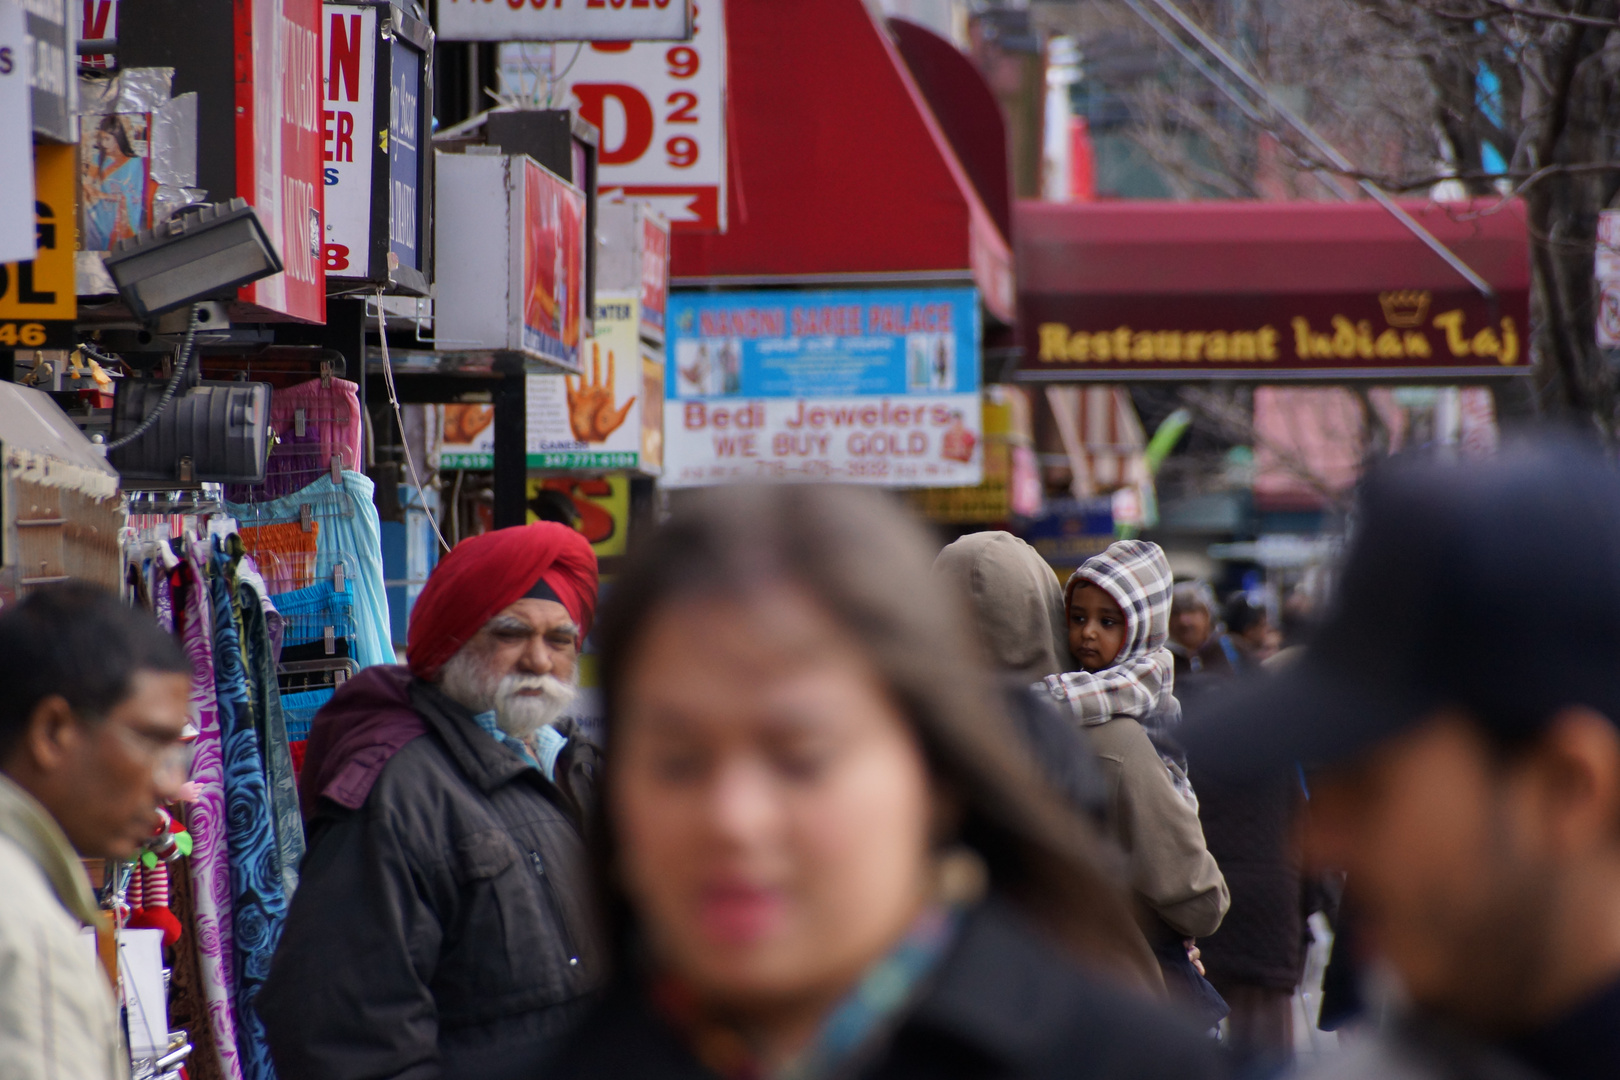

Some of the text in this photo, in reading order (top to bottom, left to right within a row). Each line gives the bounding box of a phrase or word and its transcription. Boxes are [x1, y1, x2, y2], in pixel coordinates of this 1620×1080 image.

[283, 174, 316, 285] MUSIC
[790, 305, 863, 337] SAREE
[867, 303, 953, 335] PALACE
[1037, 308, 1520, 366] Restaurant Indian Taj
[684, 400, 950, 430] Bedi Jewelers
[713, 431, 930, 458] WE BUY GOLD
